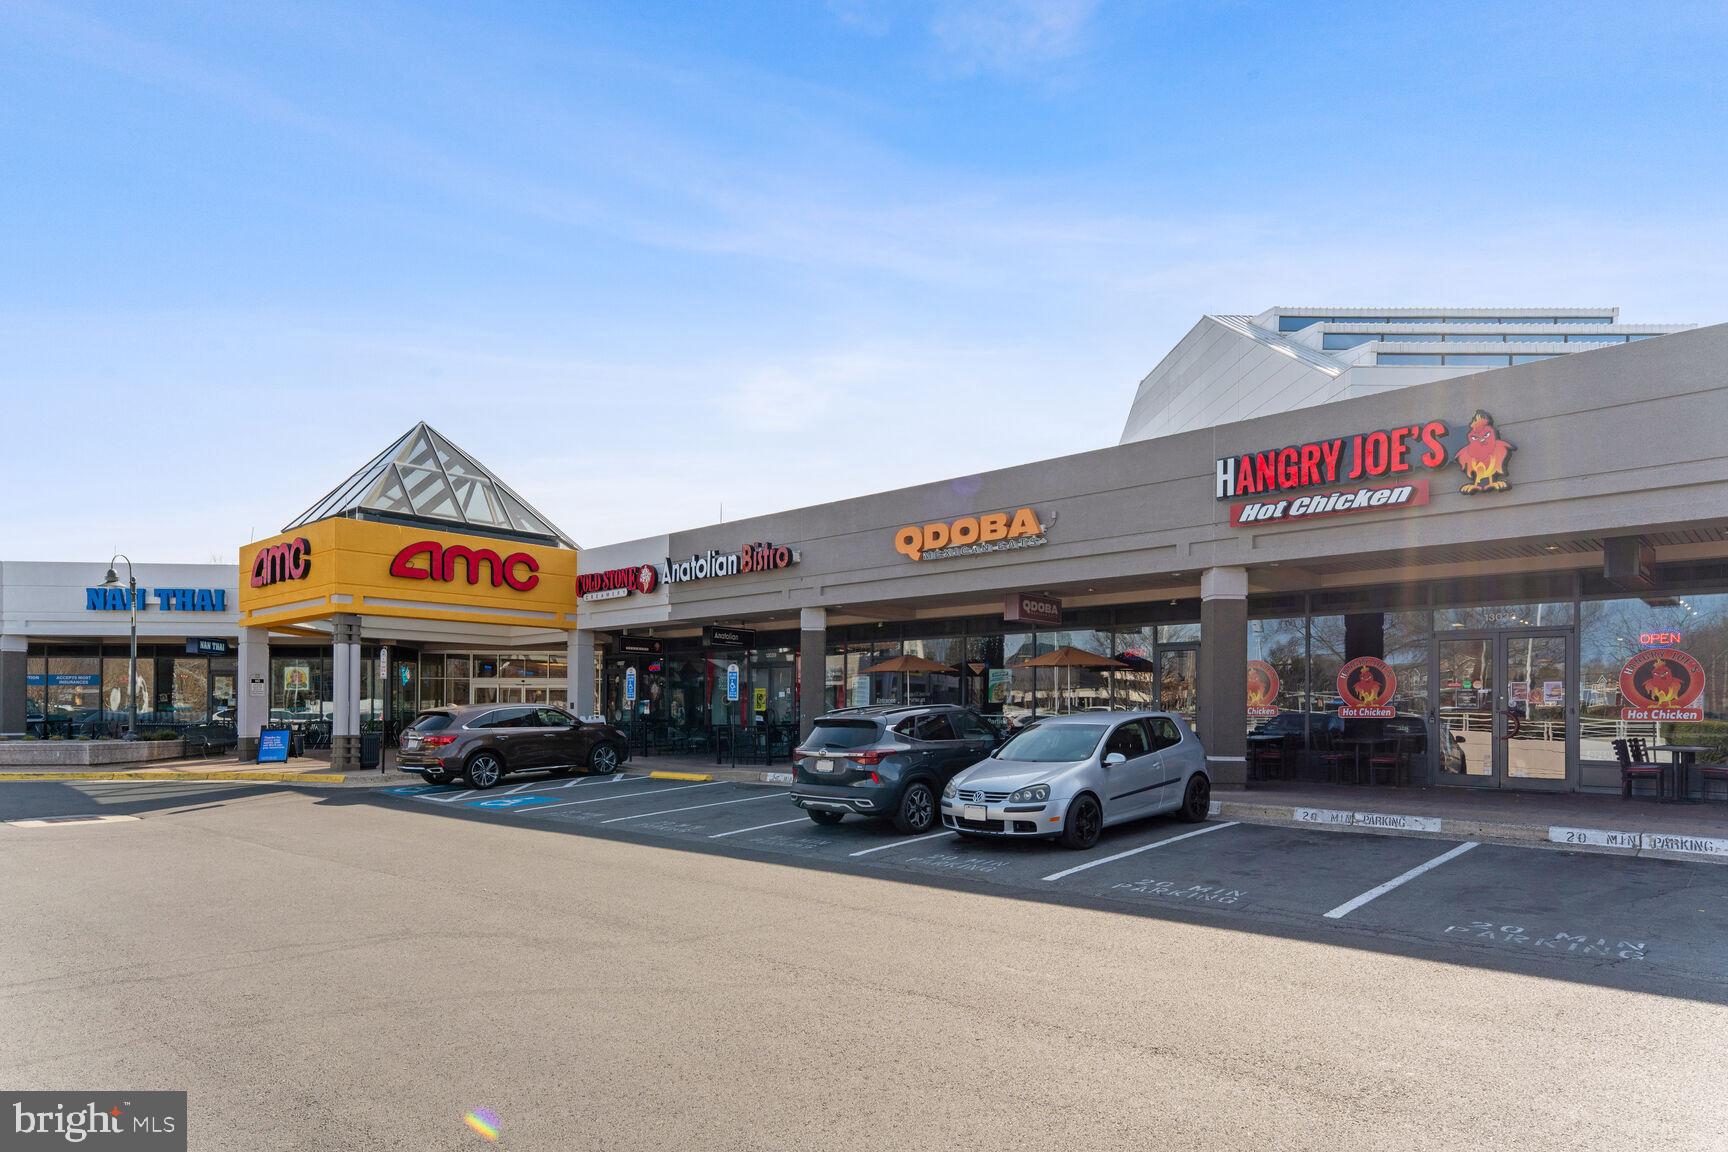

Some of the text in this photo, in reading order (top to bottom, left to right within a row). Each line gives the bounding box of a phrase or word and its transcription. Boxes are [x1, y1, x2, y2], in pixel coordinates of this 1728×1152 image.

[1216, 421, 1446, 498] HANGRY JOE'S
[1238, 486, 1413, 523] Hot Chicken
[895, 507, 1042, 561] QDOBA
[661, 542, 790, 585] Anatolian Bistro
[575, 567, 638, 598] COLD STONE
[154, 588, 226, 612] THAI
[1023, 600, 1058, 614] QDOBA
[200, 640, 225, 651] NAN THAI
[714, 631, 739, 640] Anatolian
[1640, 633, 1681, 644] OPEN
[1247, 707, 1275, 715] Chicken
[1343, 708, 1391, 716] Hot Chicken
[1627, 709, 1698, 720] Hot Chicken
[1302, 811, 1317, 821] 20
[1363, 815, 1406, 828] PARKING
[1566, 831, 1713, 852] 20 MIN PARKING
[1111, 882, 1238, 904] PARKING
[1444, 925, 1645, 960] PARKING
[1468, 921, 1645, 950] 20 MIN
